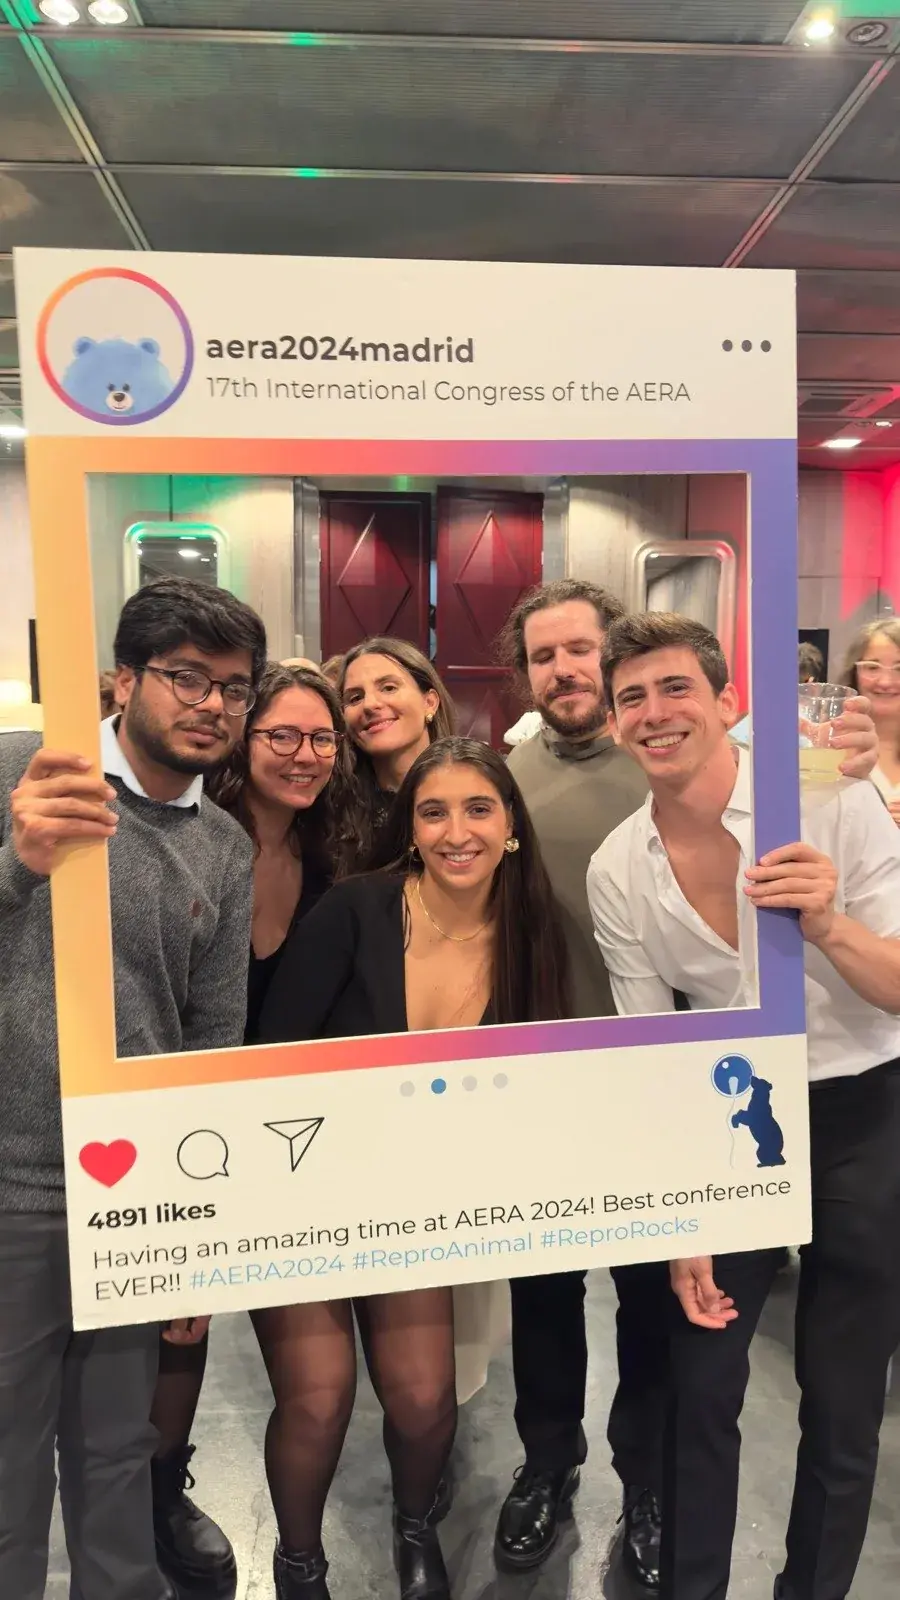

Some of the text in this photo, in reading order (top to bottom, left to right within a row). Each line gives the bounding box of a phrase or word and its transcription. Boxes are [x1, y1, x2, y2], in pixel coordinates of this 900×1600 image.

[206, 335, 475, 363] aera2024madrid
[205, 376, 692, 406] 17th International Congress of the AERA
[87, 1202, 217, 1230] 4891 likes
[93, 1180, 792, 1270] Having an amazing time at AERA 2024! Best conference
[95, 1216, 700, 1301] EVER!! #AERA2024 #ReproAnimal #ReproRocks
